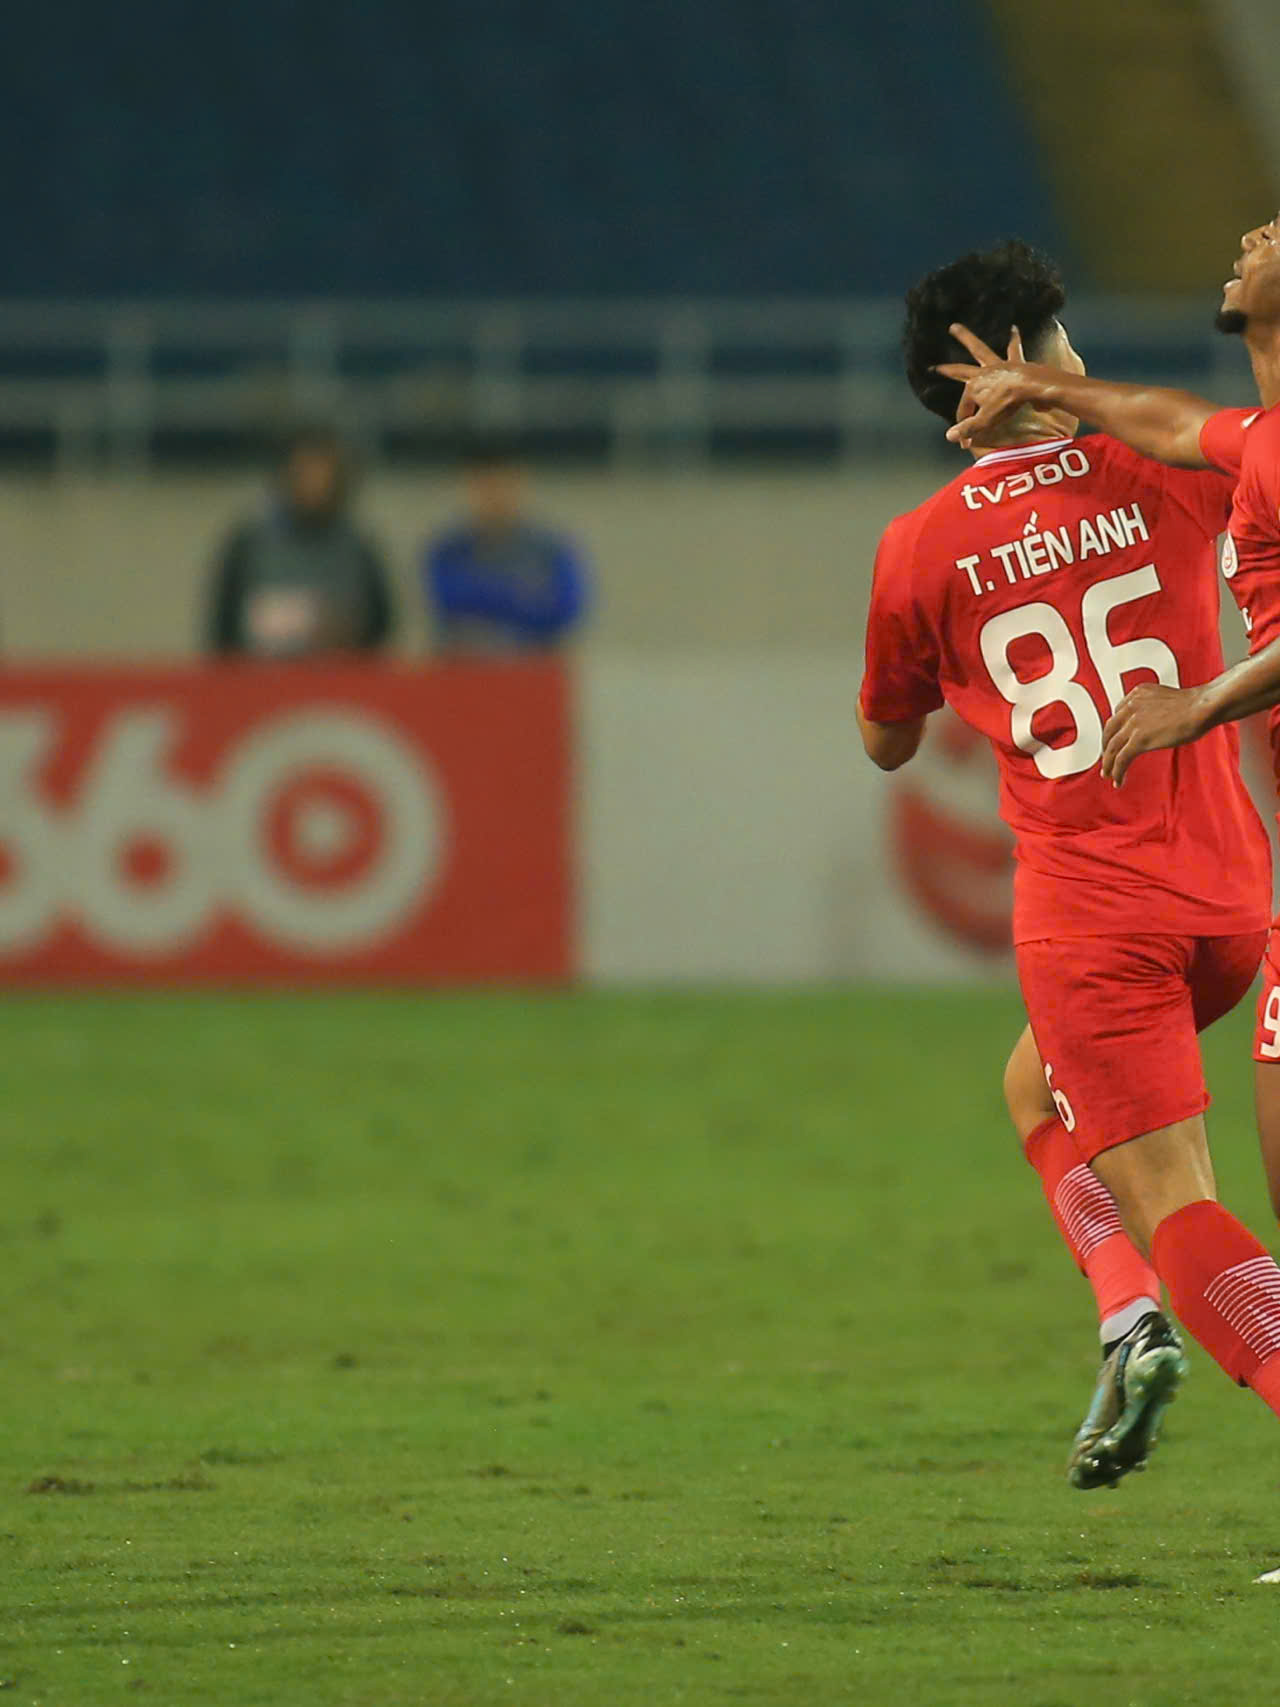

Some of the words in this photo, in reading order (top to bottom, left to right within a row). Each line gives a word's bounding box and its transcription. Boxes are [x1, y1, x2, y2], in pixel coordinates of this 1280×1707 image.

[960, 448, 1091, 511] tv360
[955, 554, 996, 596] T.
[990, 510, 1075, 585] TIẾN
[1079, 502, 1150, 560] ANH
[980, 562, 1182, 781] 86
